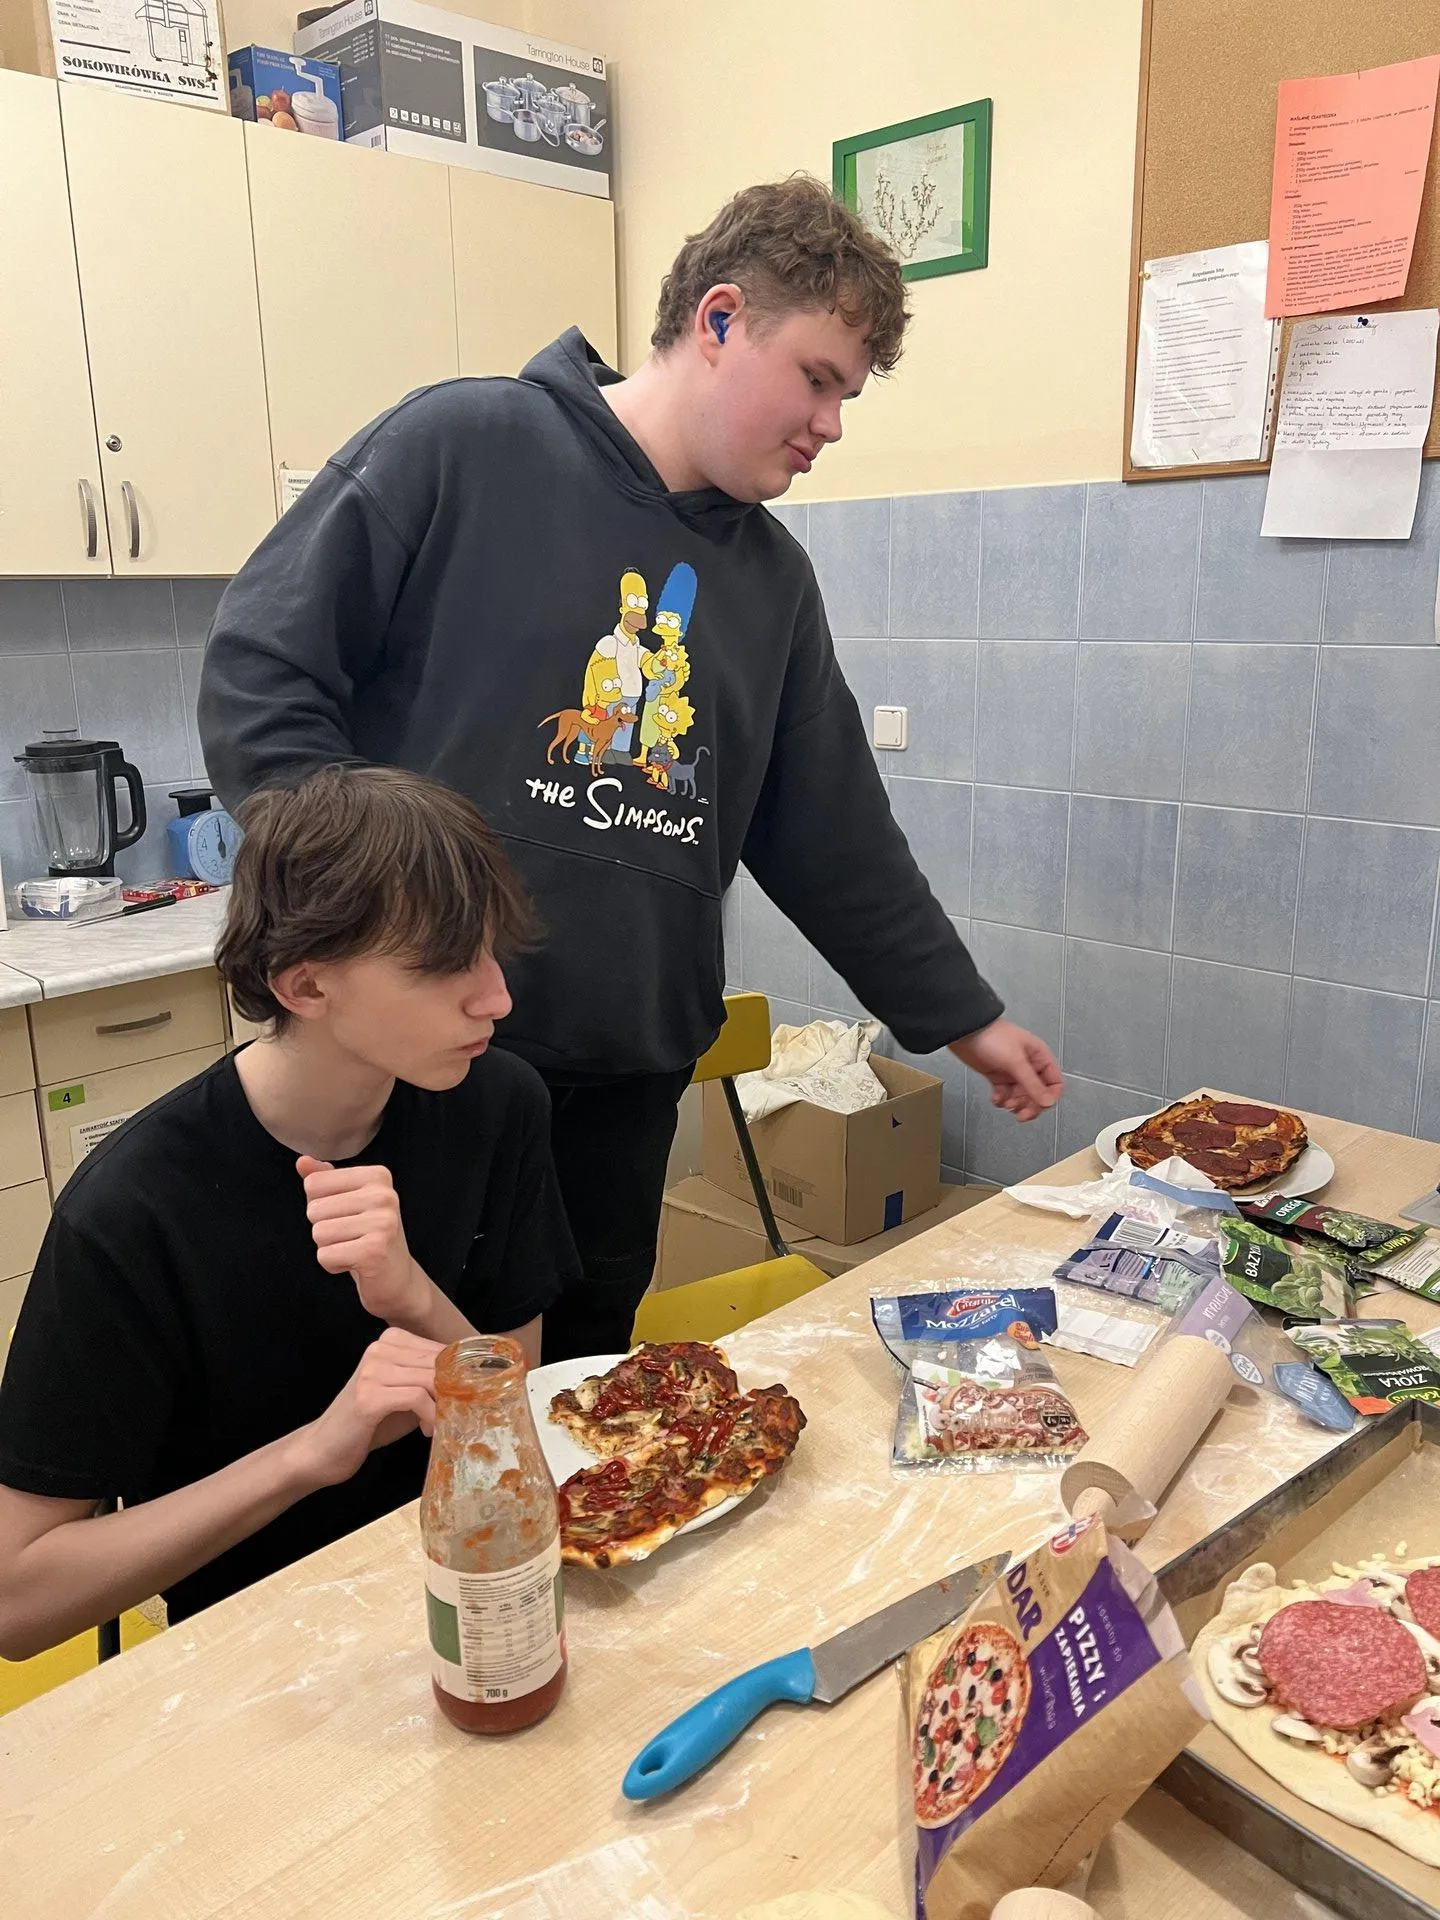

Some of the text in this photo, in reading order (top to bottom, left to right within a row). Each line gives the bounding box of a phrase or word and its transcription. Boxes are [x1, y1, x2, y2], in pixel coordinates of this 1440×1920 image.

[526, 43, 590, 71] Tarrington House
[62, 55, 217, 92] SOKOWIRÓWKA SWS-1
[201, 838, 208, 851] 4
[211, 859, 219, 873] 3
[63, 1092, 72, 1104] 4
[1275, 1199, 1304, 1218] OREGA
[1377, 1373, 1428, 1388] ZIOŁA
[1069, 1606, 1106, 1703] PIZZY i
[1054, 1627, 1086, 1718] ZAPIEKANIA
[485, 1688, 508, 1699] 700 g
